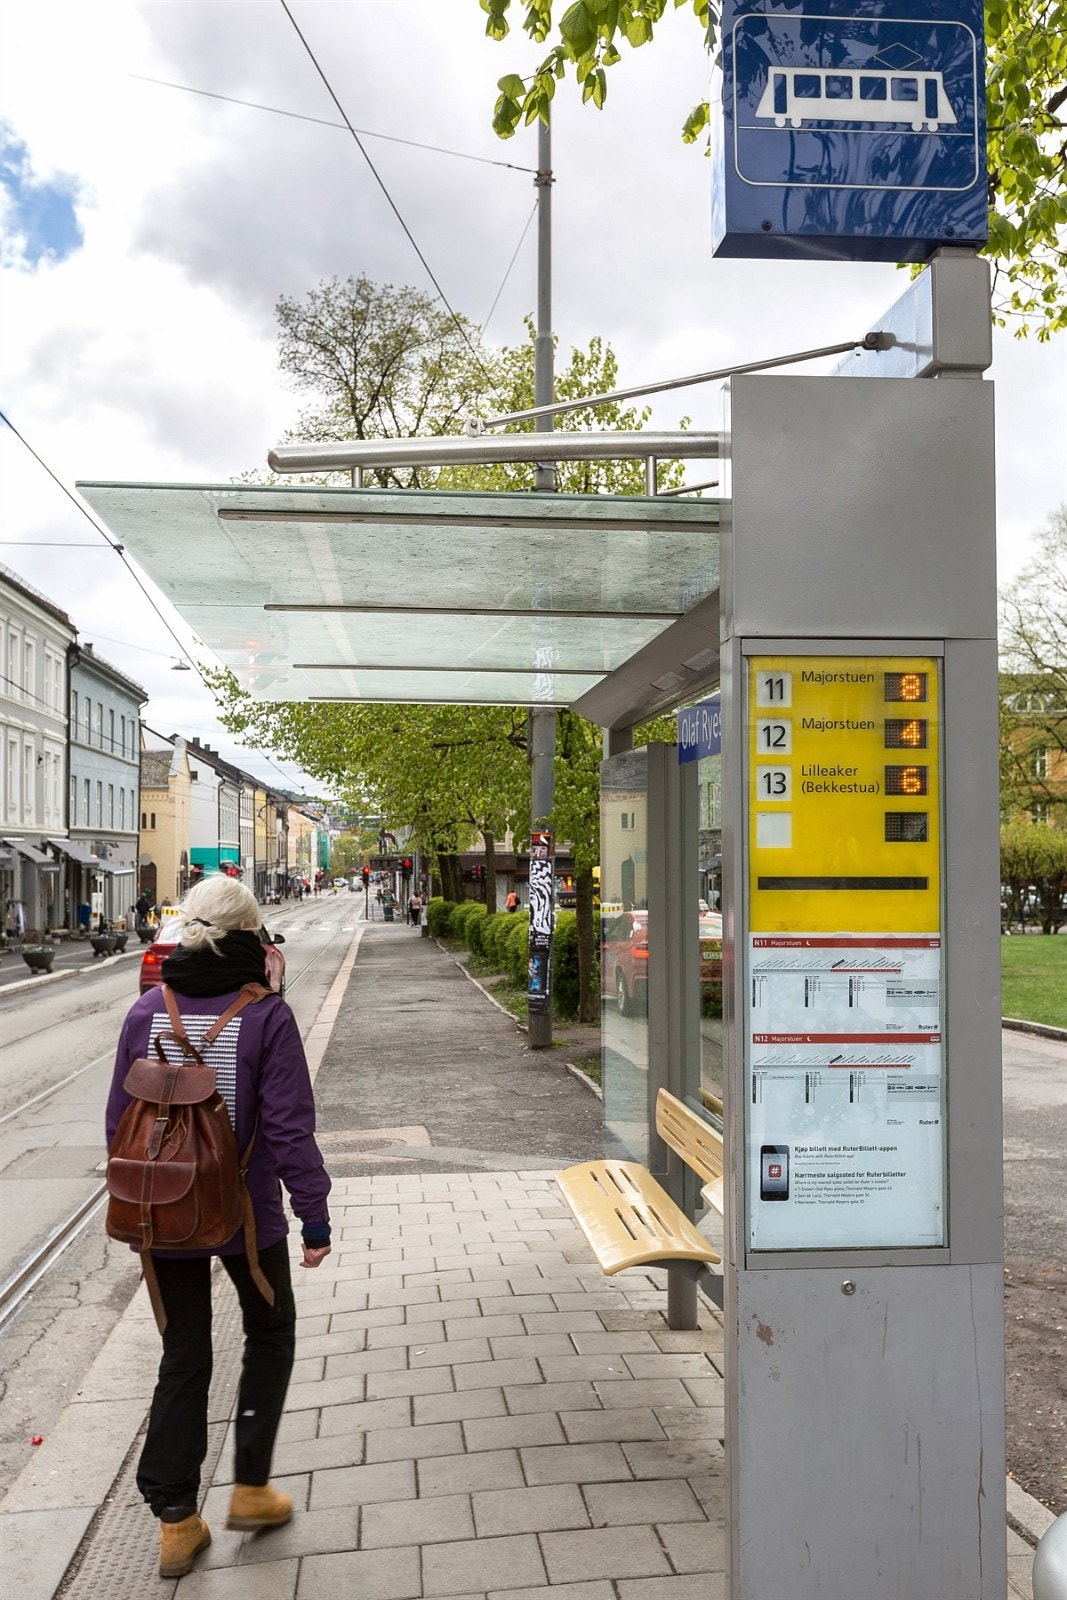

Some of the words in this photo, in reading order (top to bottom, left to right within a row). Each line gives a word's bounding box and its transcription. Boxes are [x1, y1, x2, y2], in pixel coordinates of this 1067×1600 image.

[764, 678, 785, 701] 11
[801, 670, 876, 686] Majorstuen
[900, 674, 920, 700] 8
[681, 709, 700, 750] Olaf
[763, 725, 787, 748] 12
[801, 717, 876, 732] Majorstuen
[900, 720, 920, 747] 4
[763, 772, 788, 795] 13
[801, 764, 859, 777] Lilleaker
[801, 781, 880, 794] (Bekkestua)
[900, 767, 921, 793] 6
